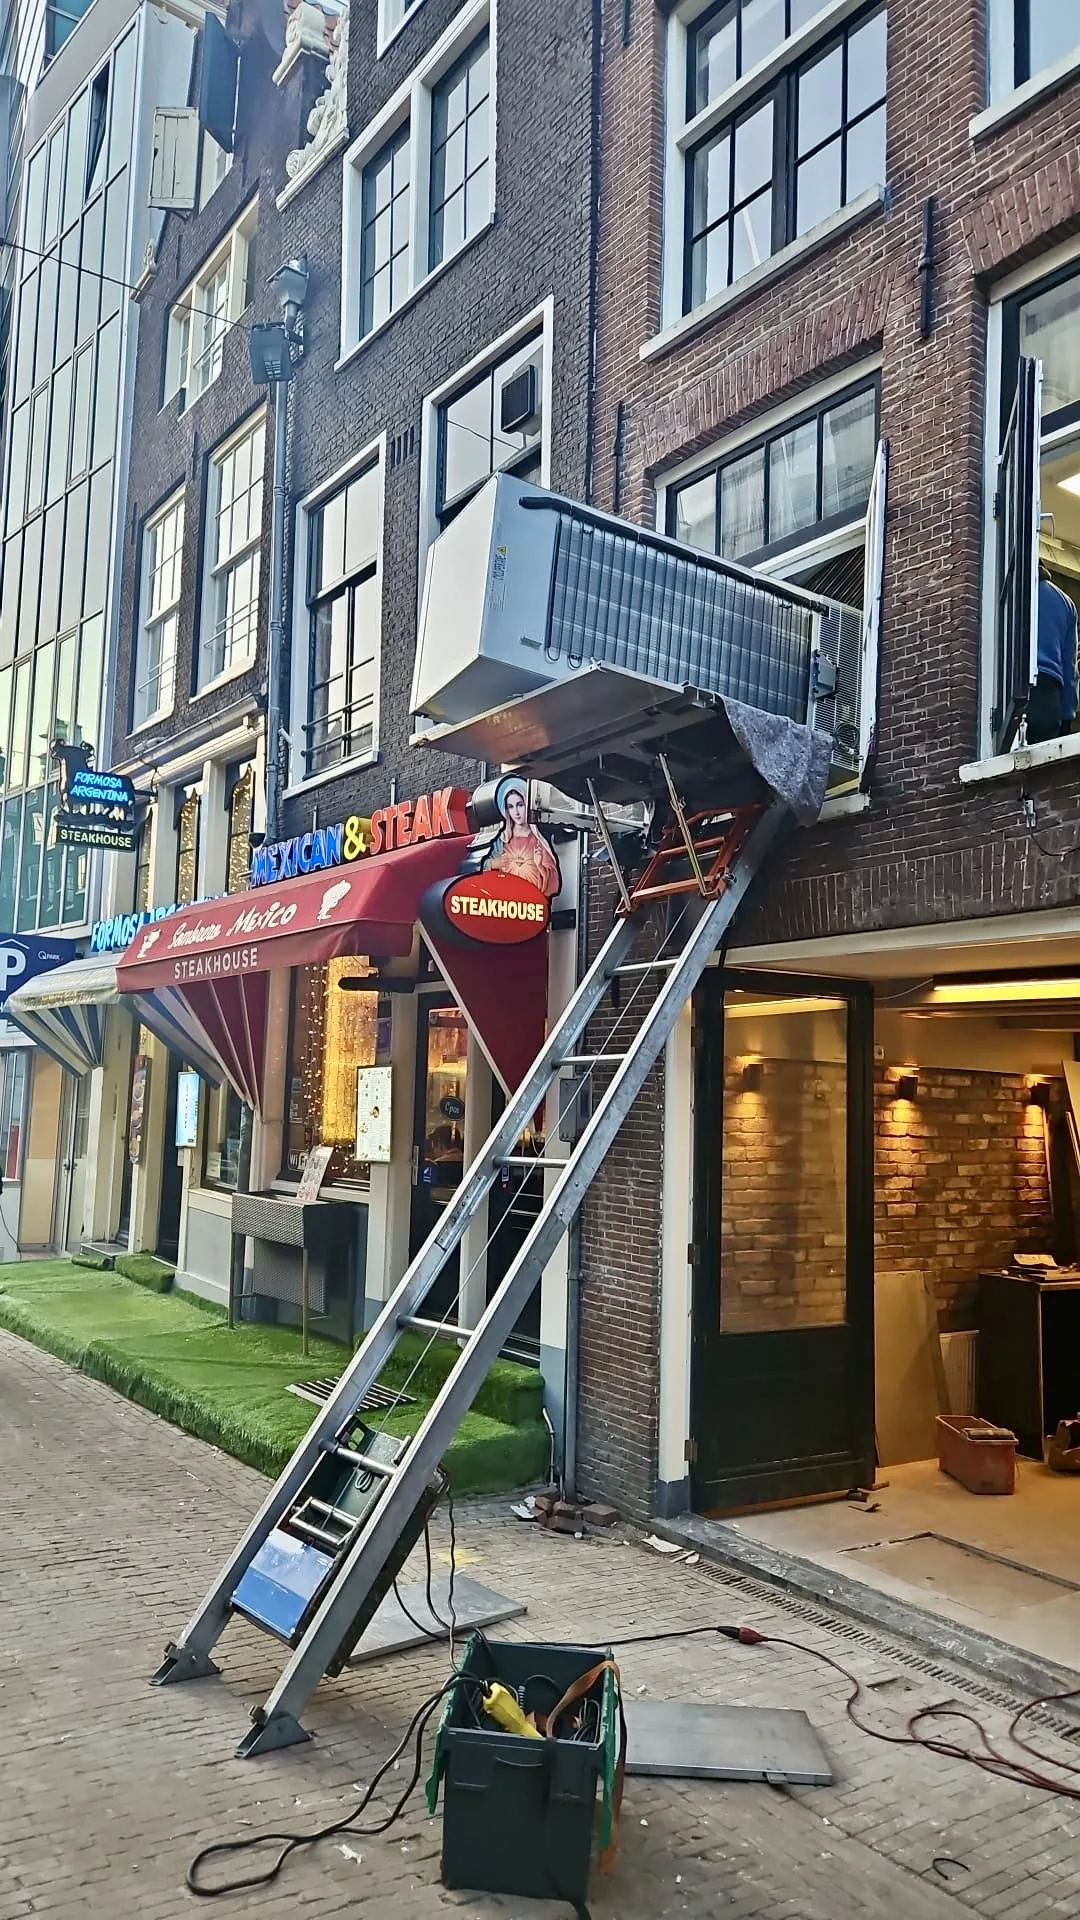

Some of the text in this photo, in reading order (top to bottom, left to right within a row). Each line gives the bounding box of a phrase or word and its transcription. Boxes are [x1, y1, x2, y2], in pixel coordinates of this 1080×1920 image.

[70, 784, 129, 802] ARGENTINA
[73, 771, 123, 789] FORMOSA
[60, 829, 132, 848] STEAKHOUSE
[251, 787, 456, 886] MEXICAN & STEAK
[450, 895, 544, 922] STEAKHOUSE
[0, 946, 26, 991] P
[174, 947, 258, 980] STEAKHOUSE
